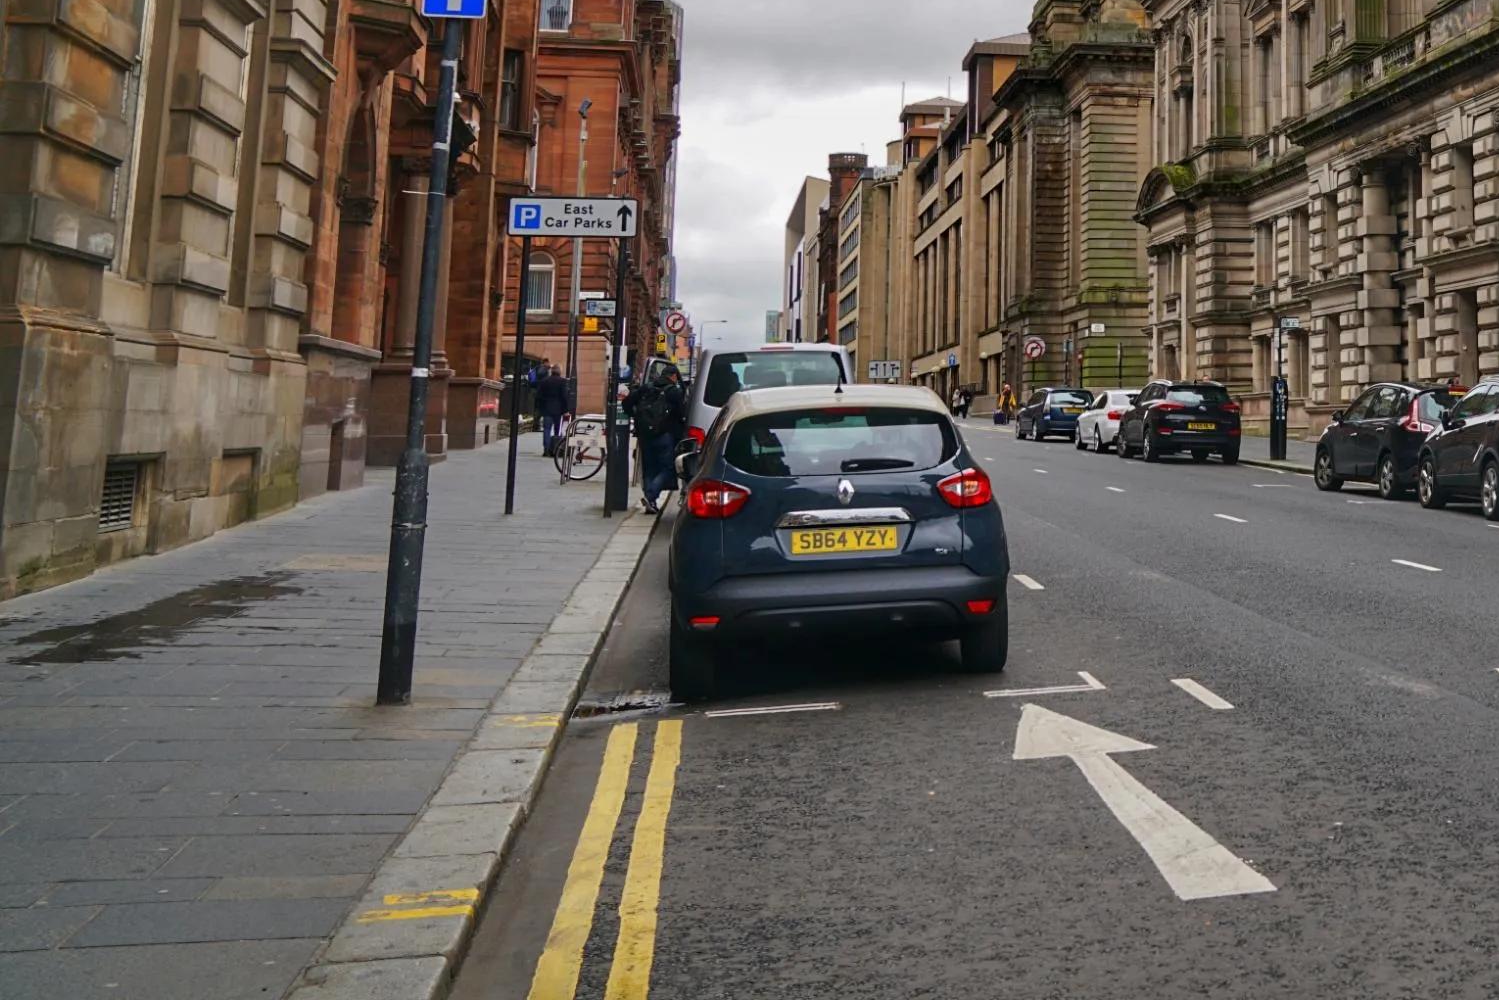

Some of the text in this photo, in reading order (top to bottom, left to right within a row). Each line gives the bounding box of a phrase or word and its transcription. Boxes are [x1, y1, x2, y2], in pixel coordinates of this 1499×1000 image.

[520, 207, 537, 227] P
[564, 203, 594, 215] East
[544, 216, 612, 229] Car Parks
[799, 529, 888, 550] SB64 YZY
